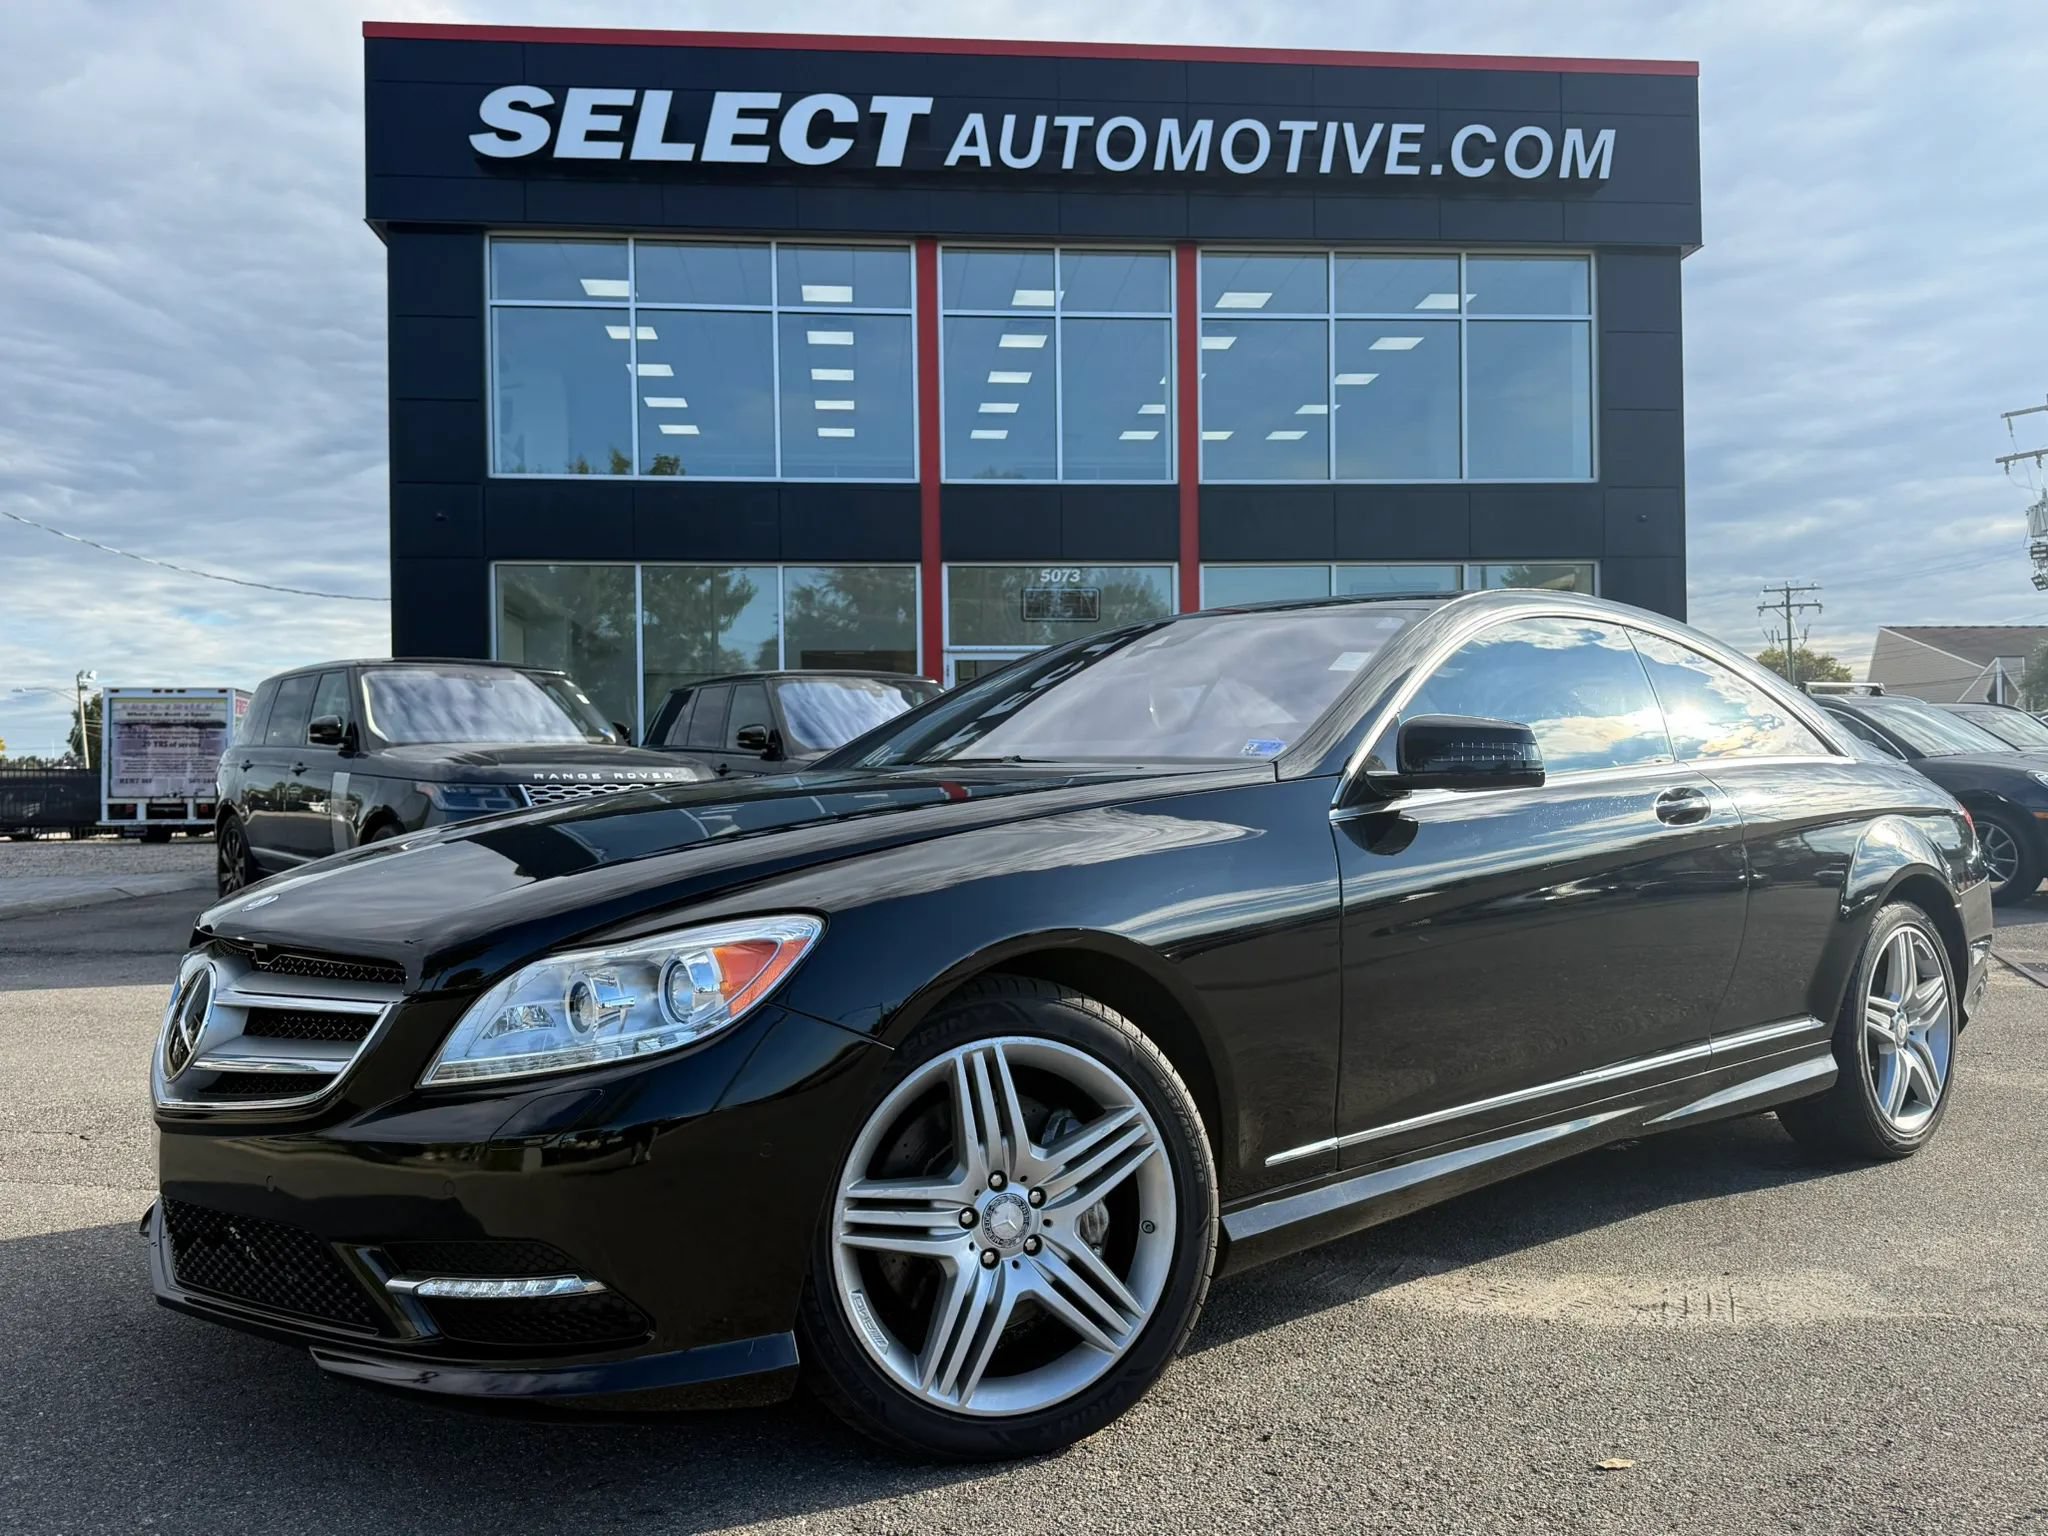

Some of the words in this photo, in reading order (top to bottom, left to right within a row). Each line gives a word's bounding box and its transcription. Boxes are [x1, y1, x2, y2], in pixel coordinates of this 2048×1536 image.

[468, 84, 934, 168] SELECT
[944, 112, 1617, 181] AUTOMOTIVE.COM
[1040, 569, 1081, 583] 5073
[533, 772, 602, 781] RANGE
[613, 772, 674, 780] ROVER
